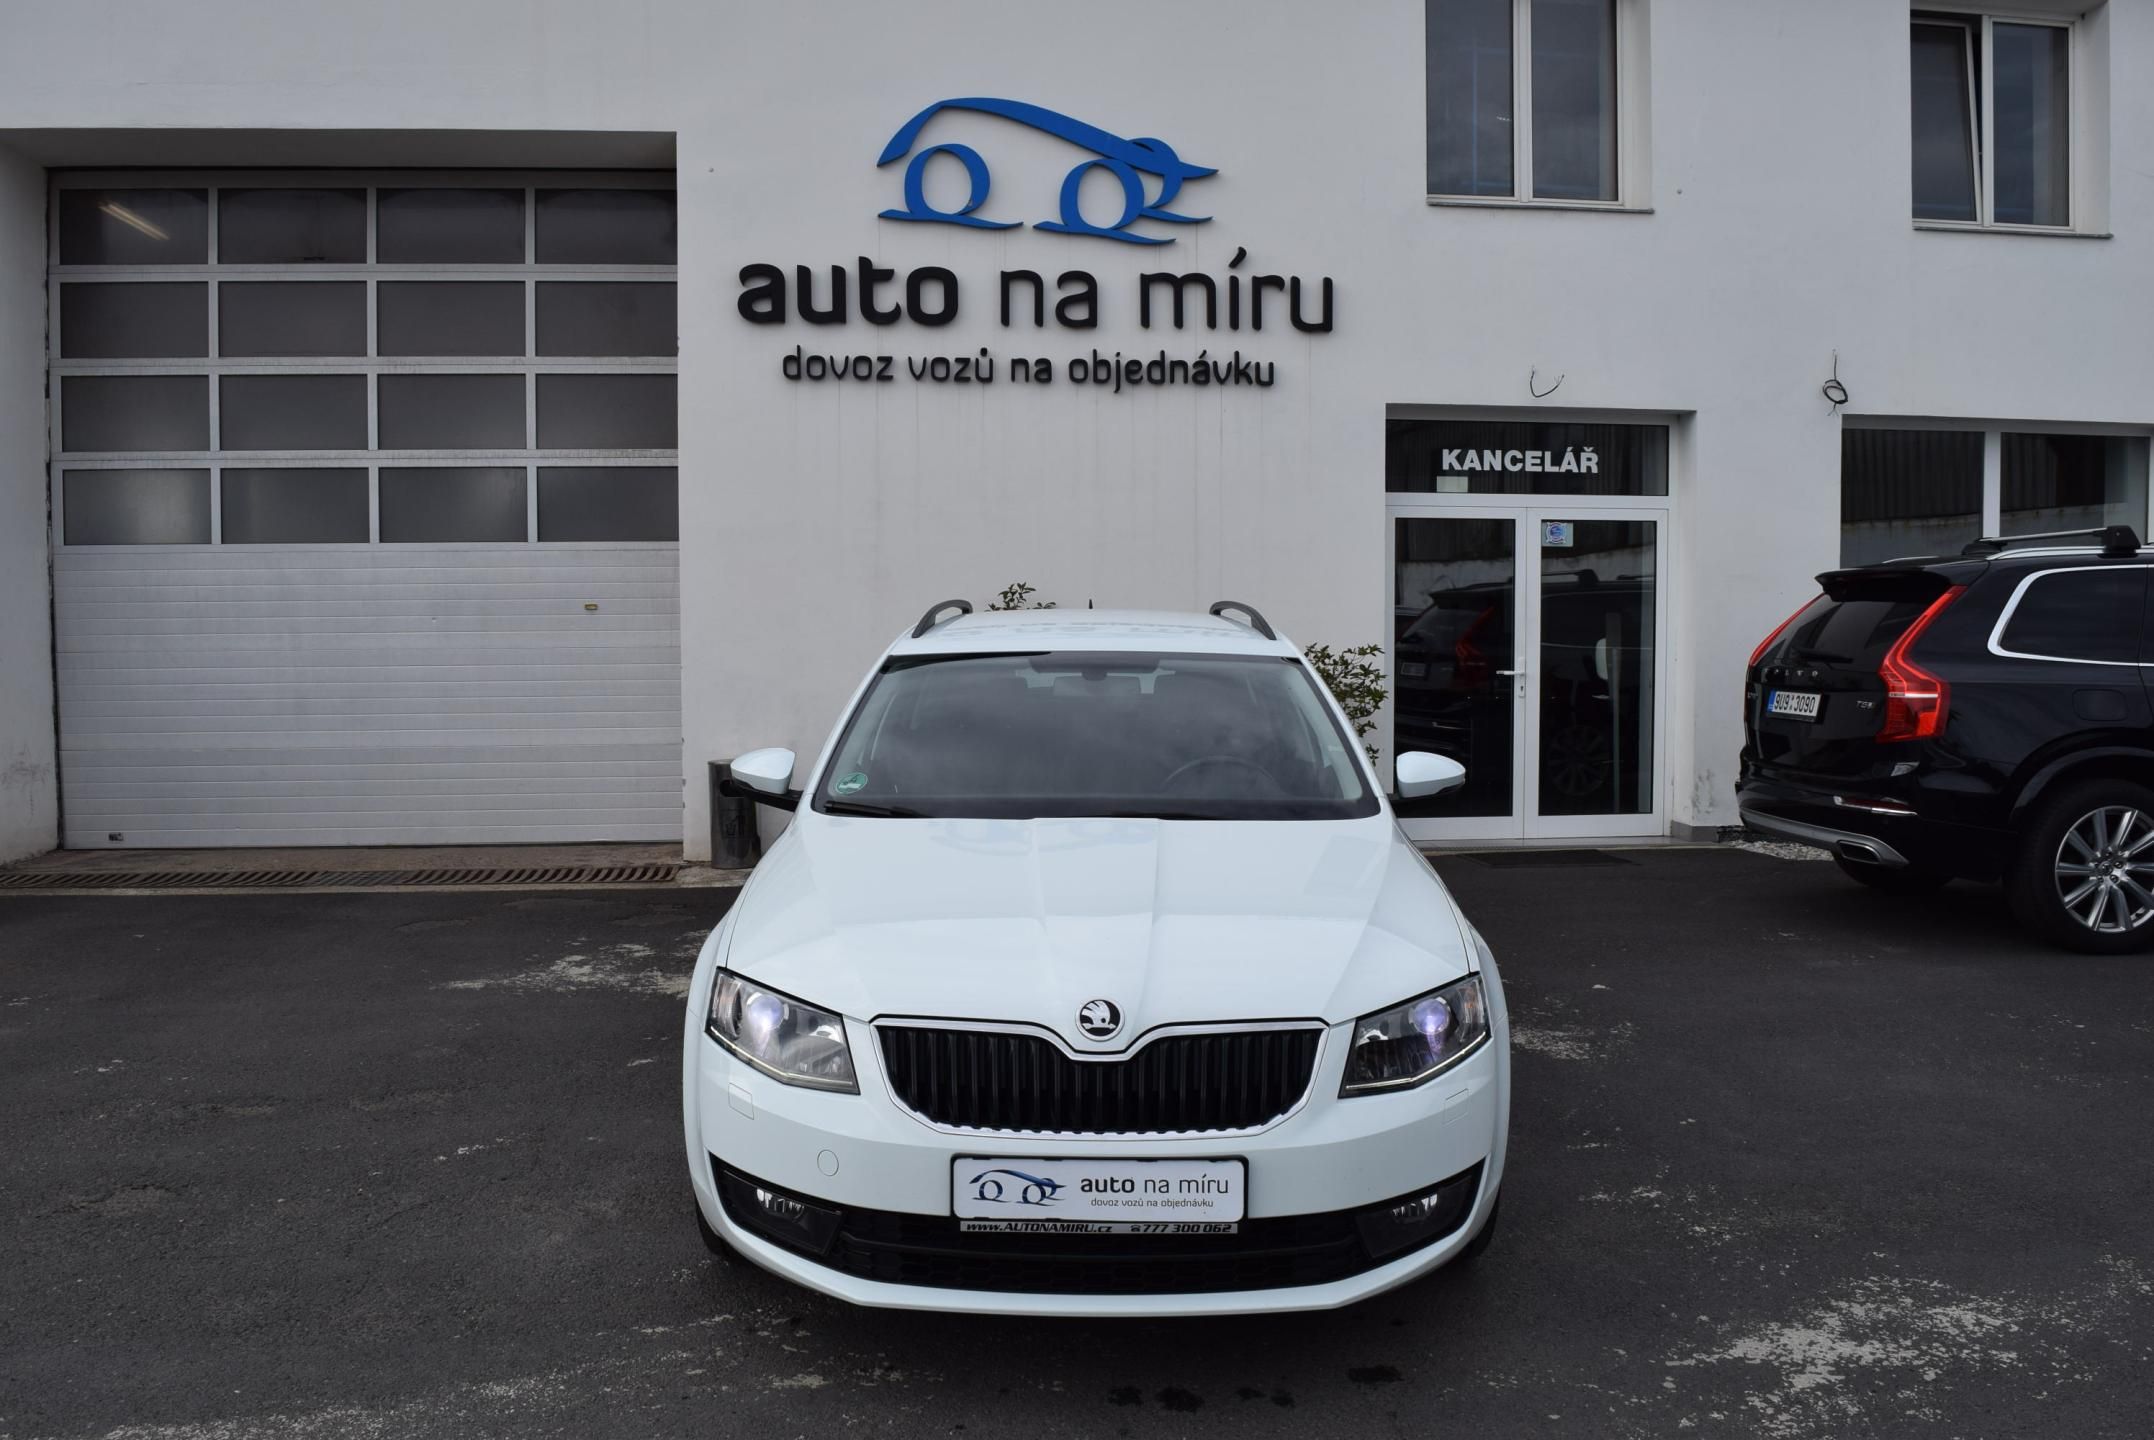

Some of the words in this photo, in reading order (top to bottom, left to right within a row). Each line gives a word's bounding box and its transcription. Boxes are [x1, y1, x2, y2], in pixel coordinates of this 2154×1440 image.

[737, 255, 958, 328] auto
[1000, 269, 1098, 330] na
[1139, 246, 1334, 333] míru
[782, 345, 894, 383] dovoz
[907, 347, 994, 385] vozů
[1010, 357, 1053, 384] na
[1068, 348, 1275, 393] objednávku
[1441, 446, 1599, 474] KANCELÁŘ
[1080, 1176, 1135, 1193] auto
[1144, 1179, 1169, 1193] na
[1179, 1173, 1229, 1194] míru
[1090, 1197, 1119, 1207] dovoz
[1121, 1198, 1144, 1207] vozů
[1160, 1198, 1214, 1209] objednávku
[966, 1222, 1113, 1233] www.AUTONAMIRU.cz
[1143, 1224, 1169, 1233] 777
[1171, 1224, 1200, 1233] 300
[1202, 1224, 1232, 1233] 062
